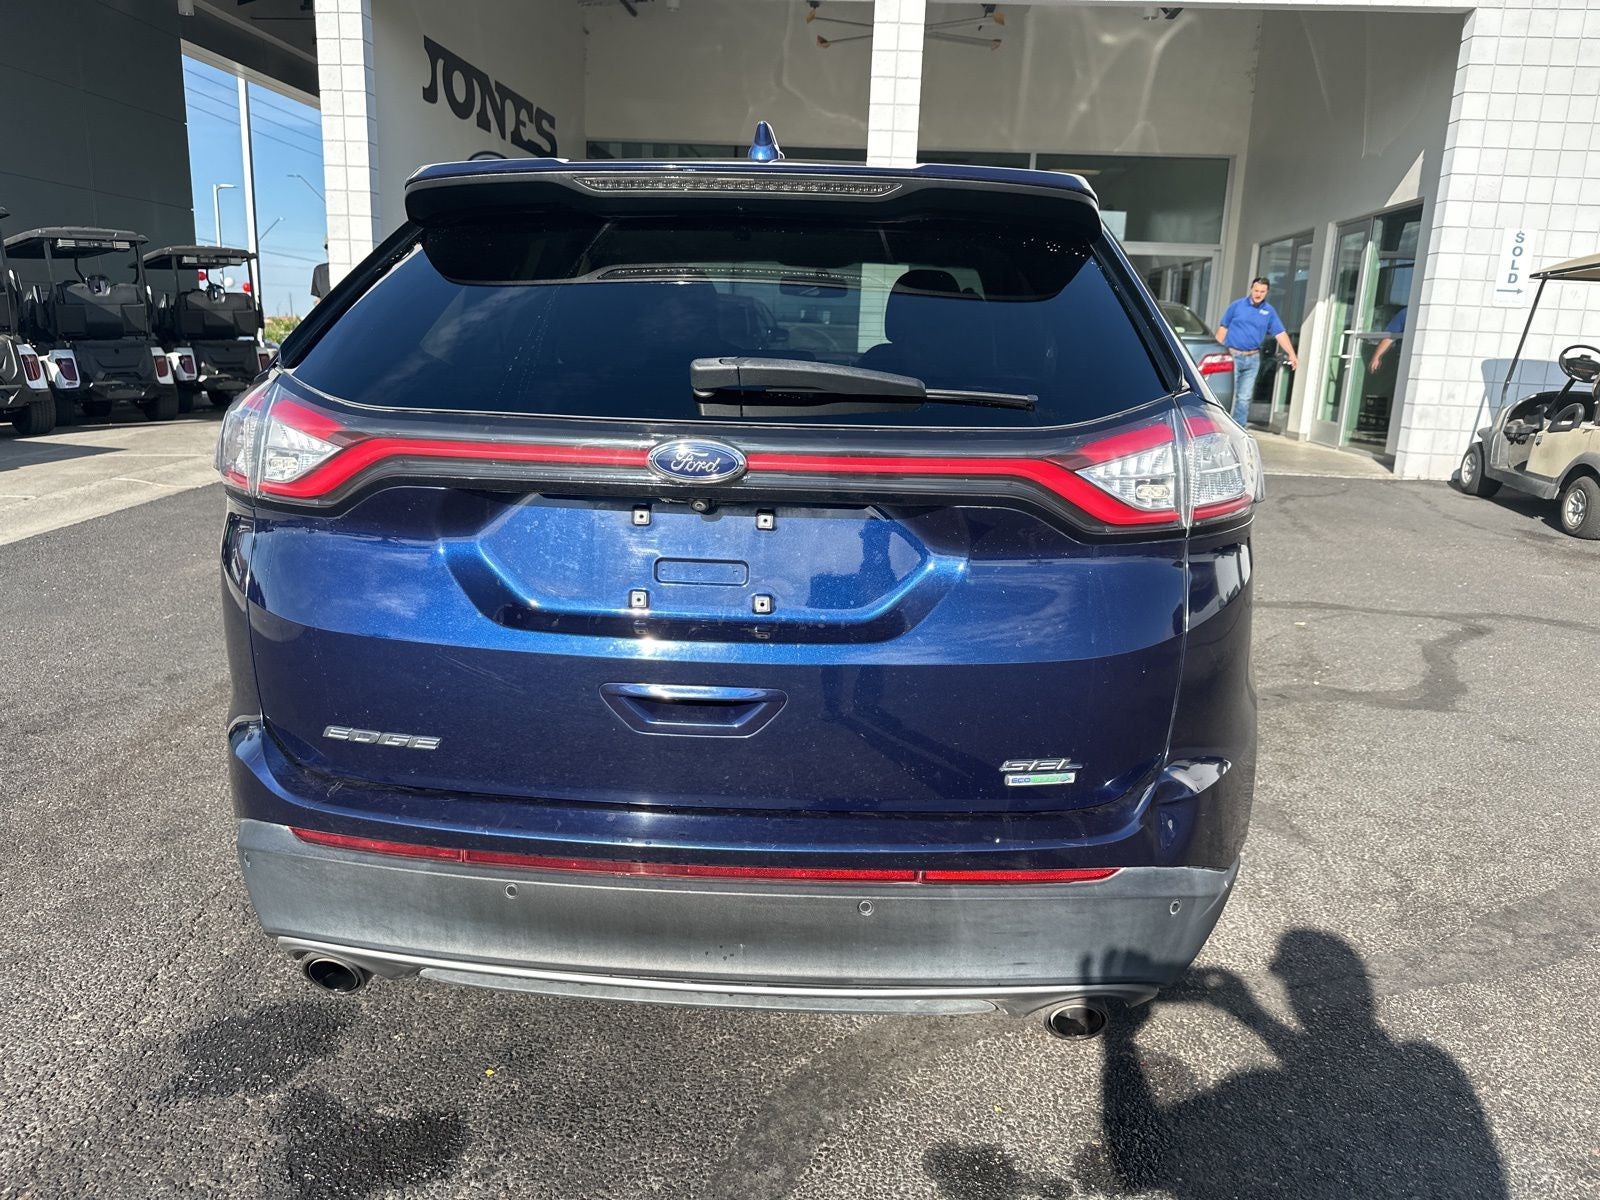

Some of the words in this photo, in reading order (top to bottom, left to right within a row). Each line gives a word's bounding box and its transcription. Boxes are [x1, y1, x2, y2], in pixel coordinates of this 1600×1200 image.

[422, 35, 557, 158] JONES
[1507, 231, 1525, 284] SOLD
[671, 449, 721, 472] Ford
[322, 725, 441, 750] EDGE
[999, 758, 1083, 772] SEL
